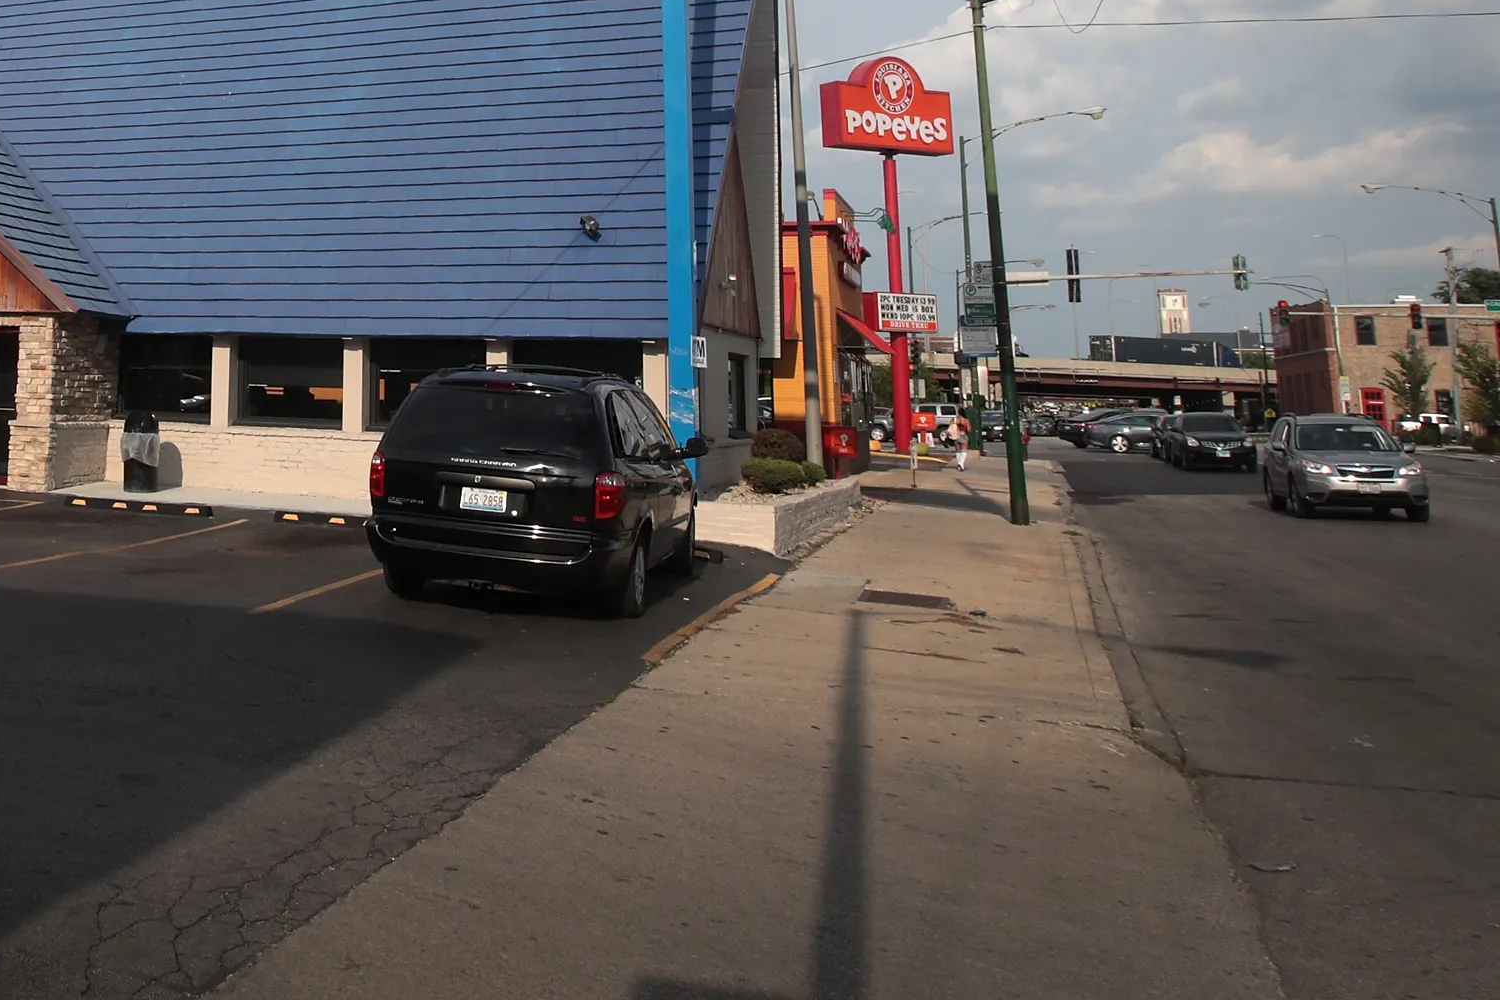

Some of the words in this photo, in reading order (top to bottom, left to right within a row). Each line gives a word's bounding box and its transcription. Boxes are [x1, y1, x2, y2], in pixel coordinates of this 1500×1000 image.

[875, 63, 911, 86] LOUISIANA
[884, 74, 903, 100] P
[876, 94, 911, 112] KITCHEN
[880, 295, 891, 303] 2PC
[892, 296, 919, 304] TUESDAY
[911, 321, 929, 329] THRU
[464, 492, 479, 505] L65
[483, 495, 503, 507] 2858
